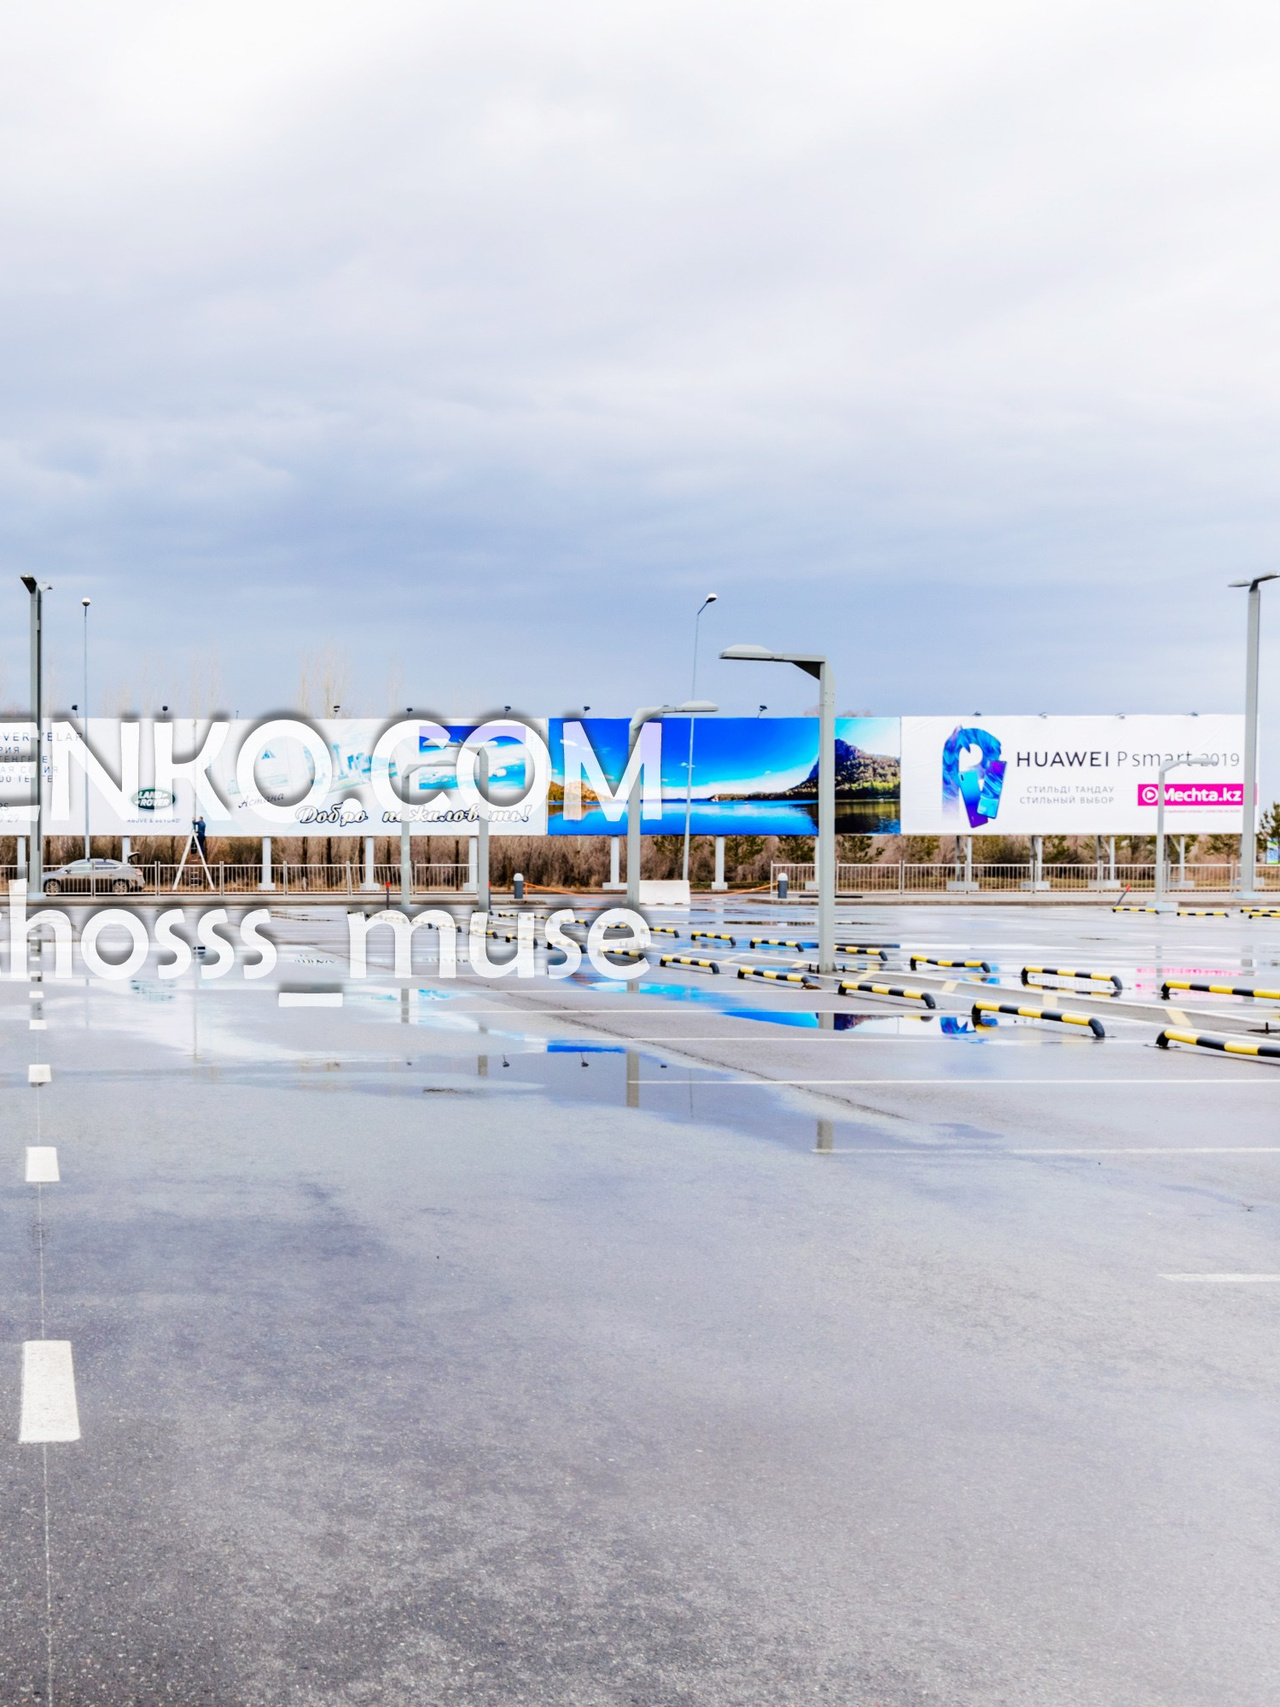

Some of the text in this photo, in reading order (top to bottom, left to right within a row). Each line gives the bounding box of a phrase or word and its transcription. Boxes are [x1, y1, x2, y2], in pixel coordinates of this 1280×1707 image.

[1016, 750, 1240, 768] HUAWEI P smart 2019
[139, 791, 162, 799] LAND
[238, 792, 285, 809] Астана
[1019, 796, 1115, 804] СТИЛЬНЫЙ ВЫБОР
[1163, 786, 1242, 802] Mechta.kz
[140, 798, 170, 807] ROVER
[295, 801, 369, 827] Добро
